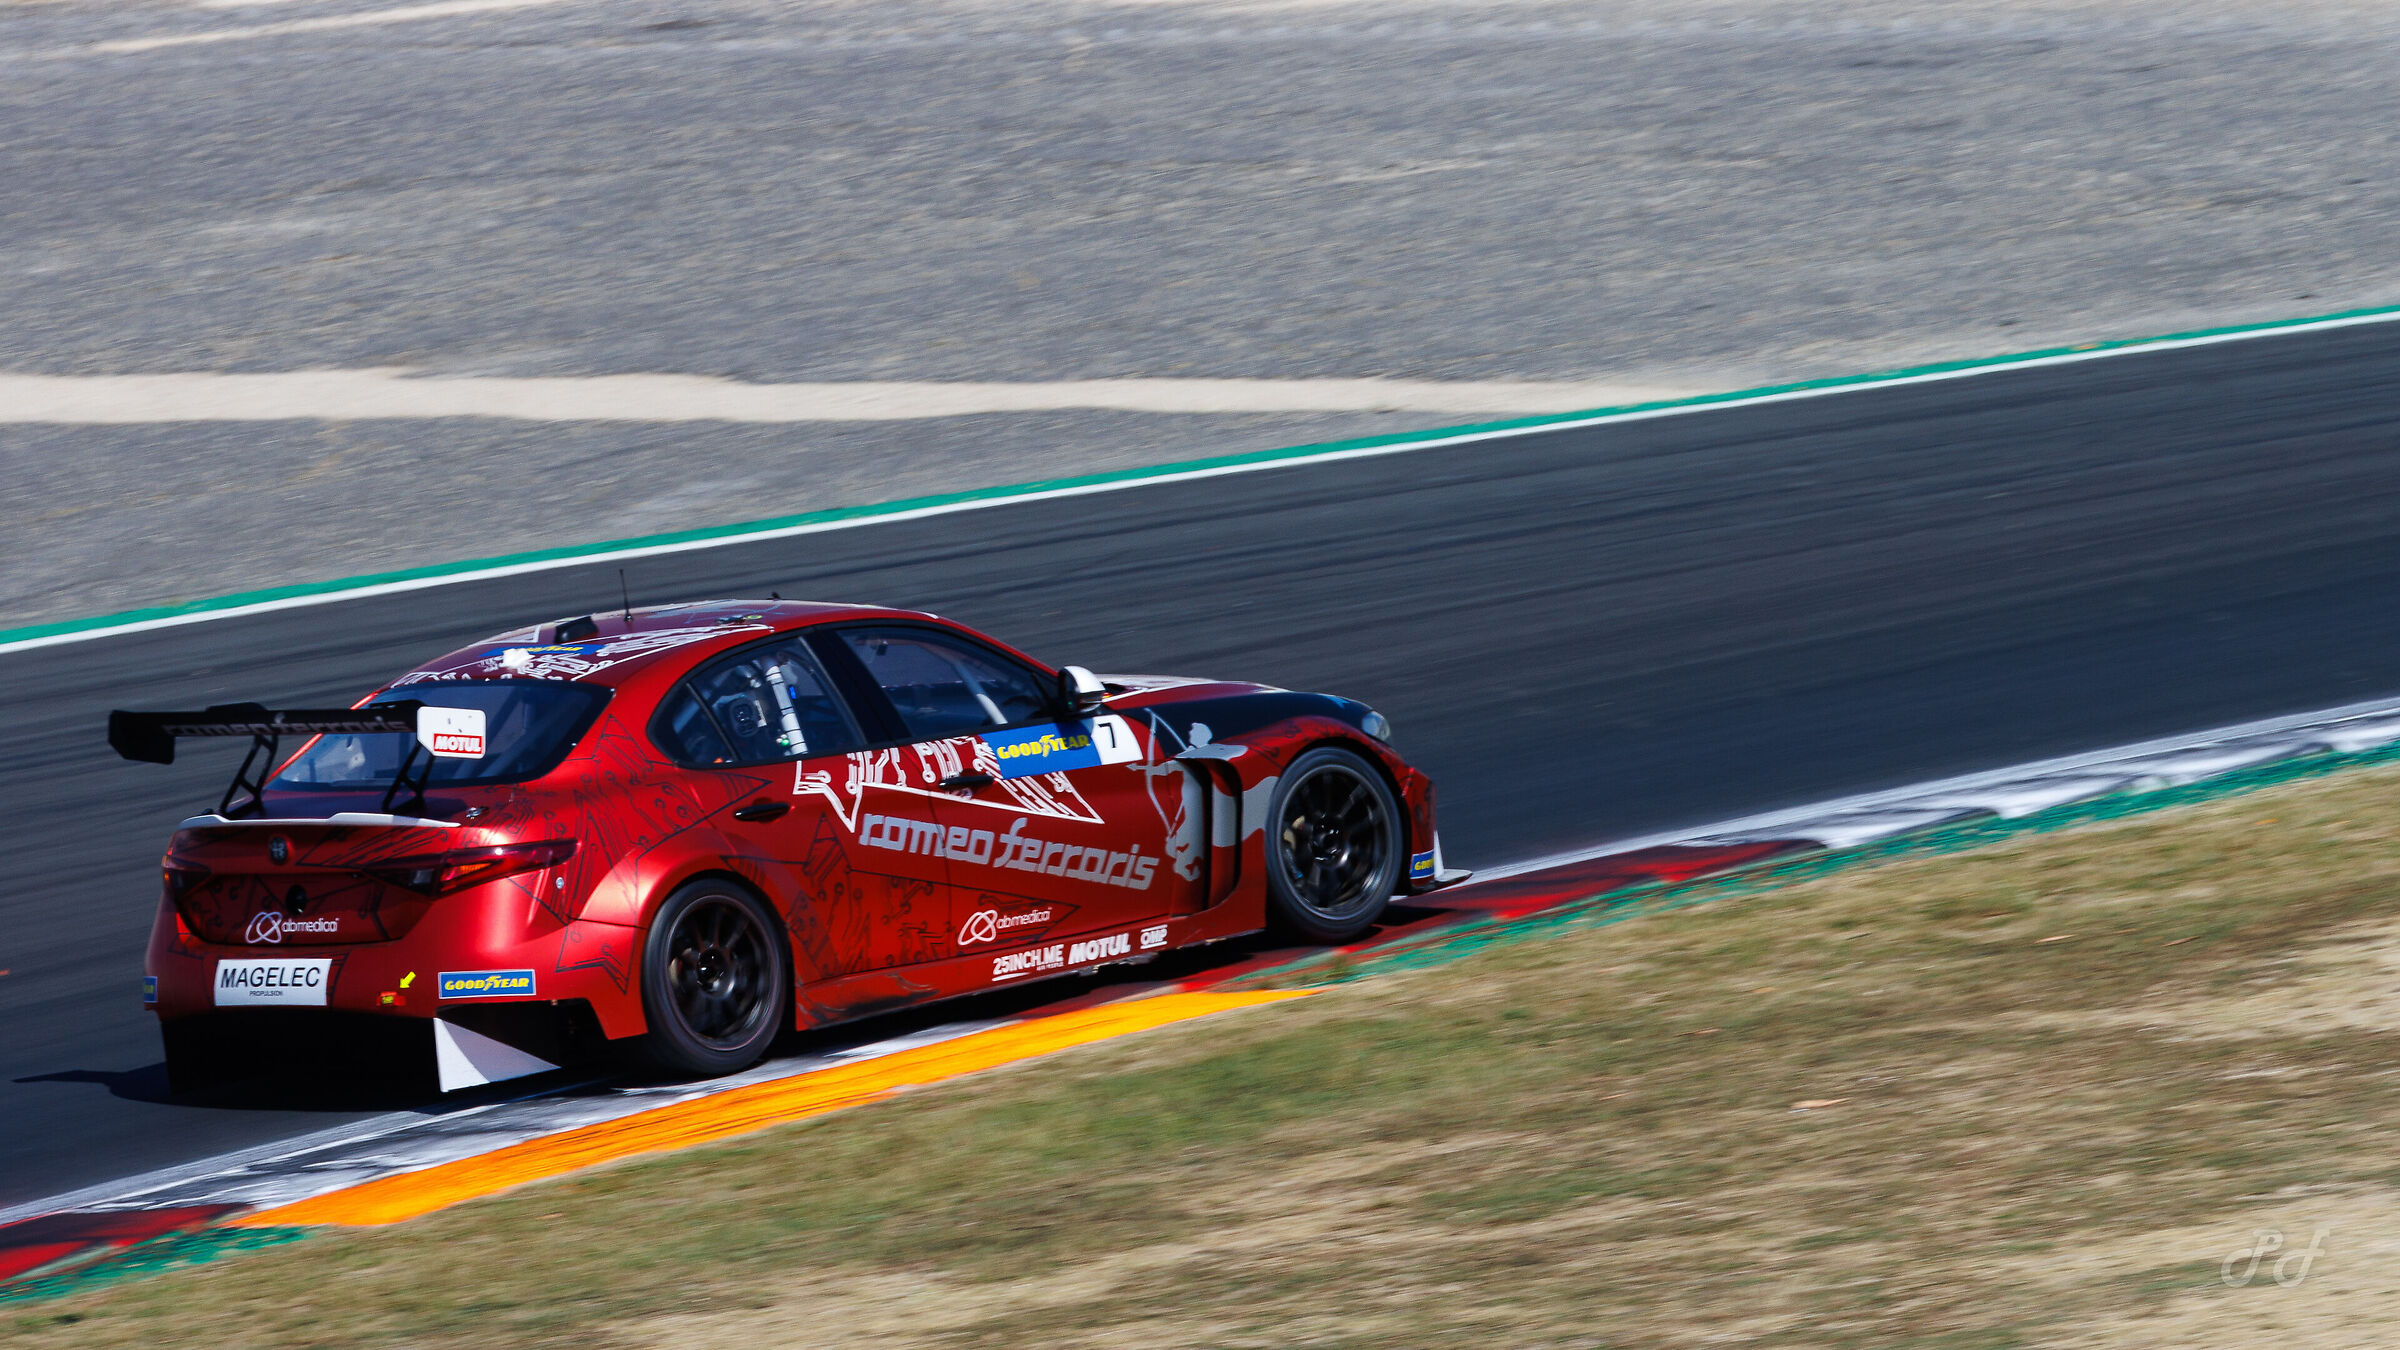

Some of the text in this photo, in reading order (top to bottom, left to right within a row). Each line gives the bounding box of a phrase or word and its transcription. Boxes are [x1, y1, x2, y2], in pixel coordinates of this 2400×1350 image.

[435, 736, 481, 752] MOTUL
[997, 734, 1090, 759] GOODYEAR
[1098, 722, 1116, 749] 7
[859, 813, 1159, 890] romeo ferraris
[1068, 932, 1131, 964] MOTUL
[1140, 928, 1168, 946] OMP
[993, 943, 1064, 975] 25INCH.ME
[220, 966, 321, 988] MAGELEC
[445, 975, 530, 991] GOODYEAR
